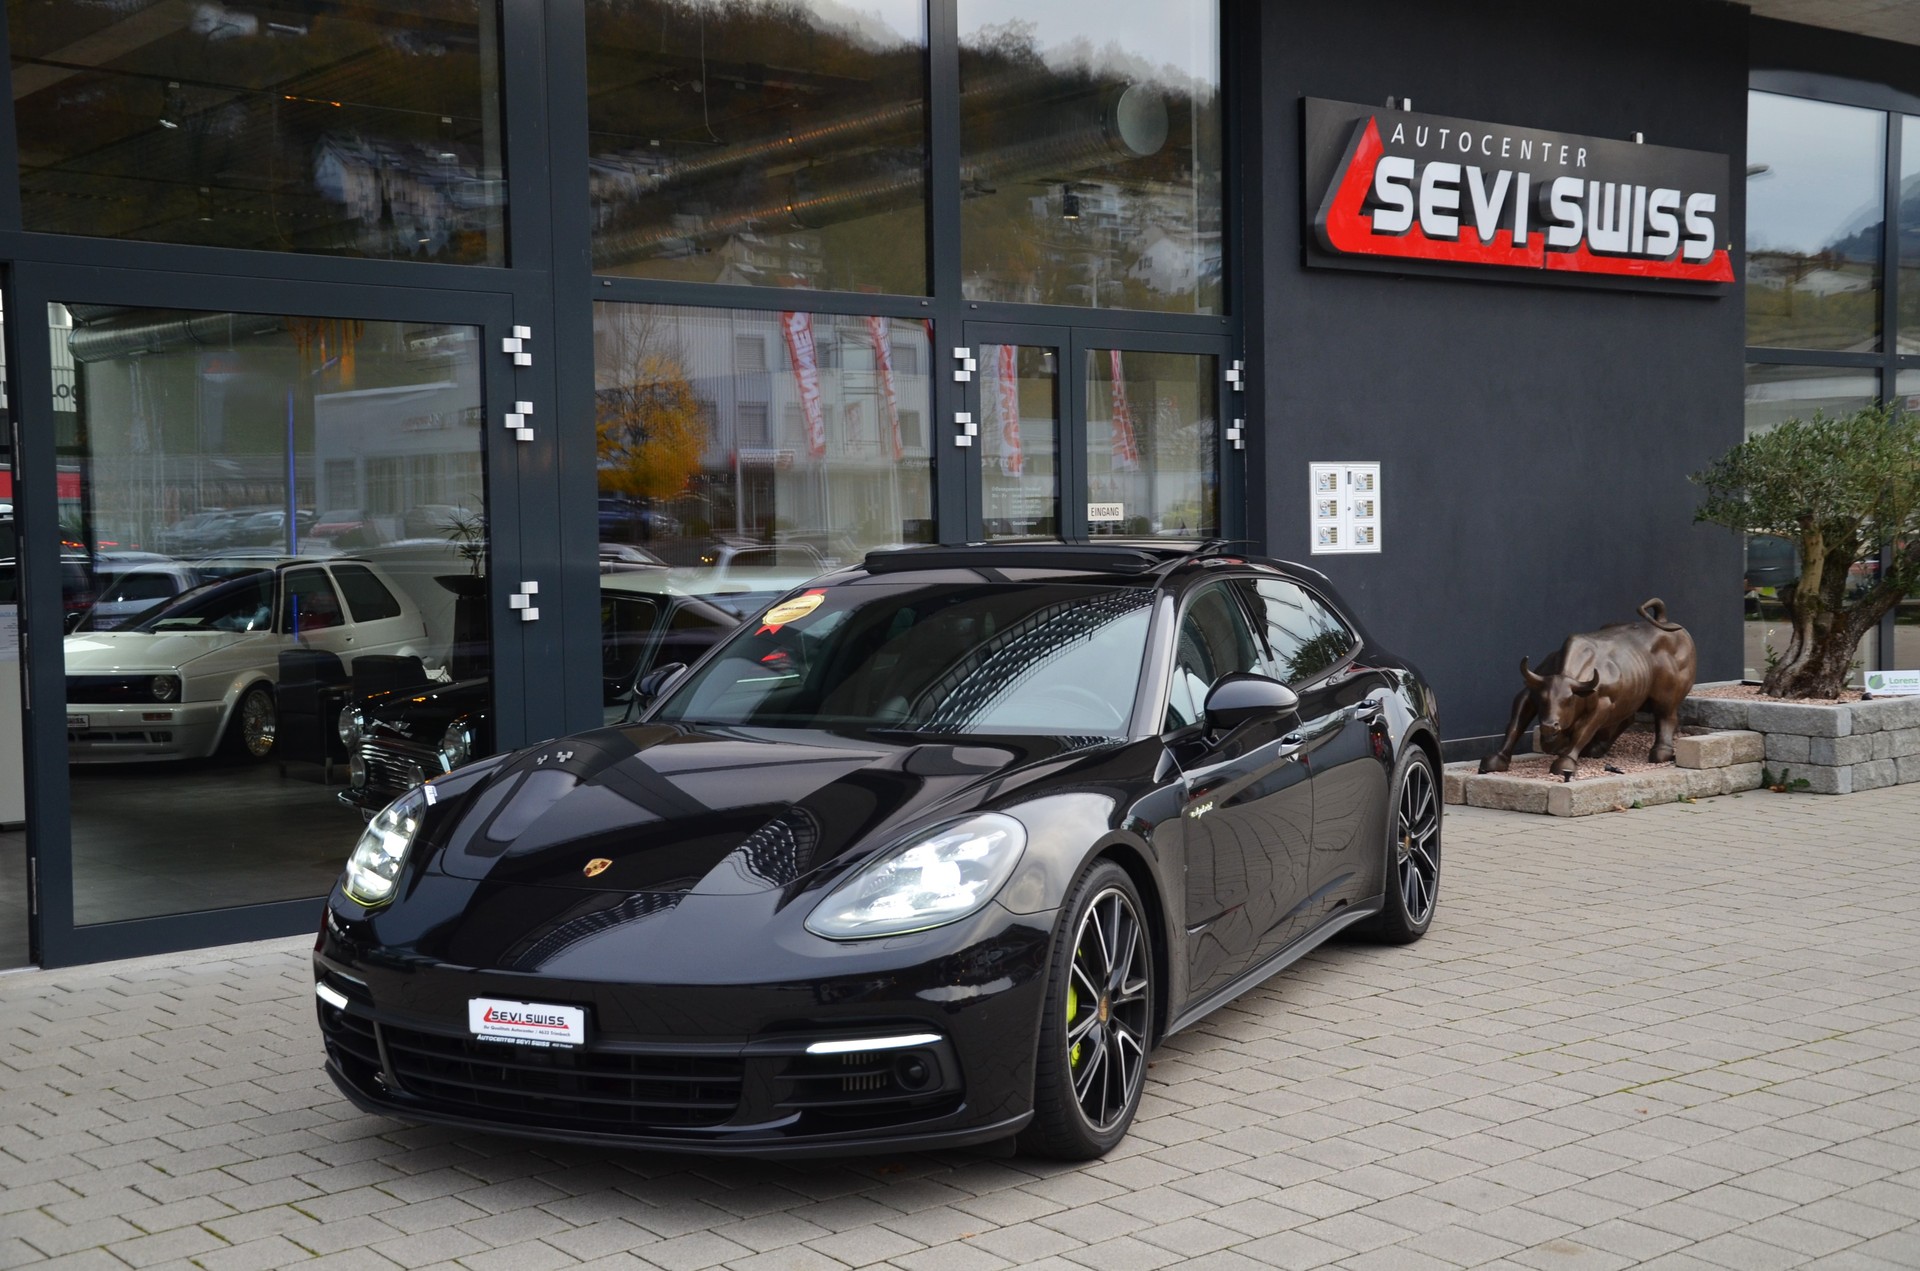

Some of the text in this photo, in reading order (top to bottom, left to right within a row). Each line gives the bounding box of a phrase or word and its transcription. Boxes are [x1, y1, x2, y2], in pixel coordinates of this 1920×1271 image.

[1390, 122, 1587, 168] AUTOCENTER
[1371, 155, 1716, 260] SEVI SWISS
[1091, 507, 1120, 517] EINGANG
[491, 1011, 565, 1026] SEVI SWISS
